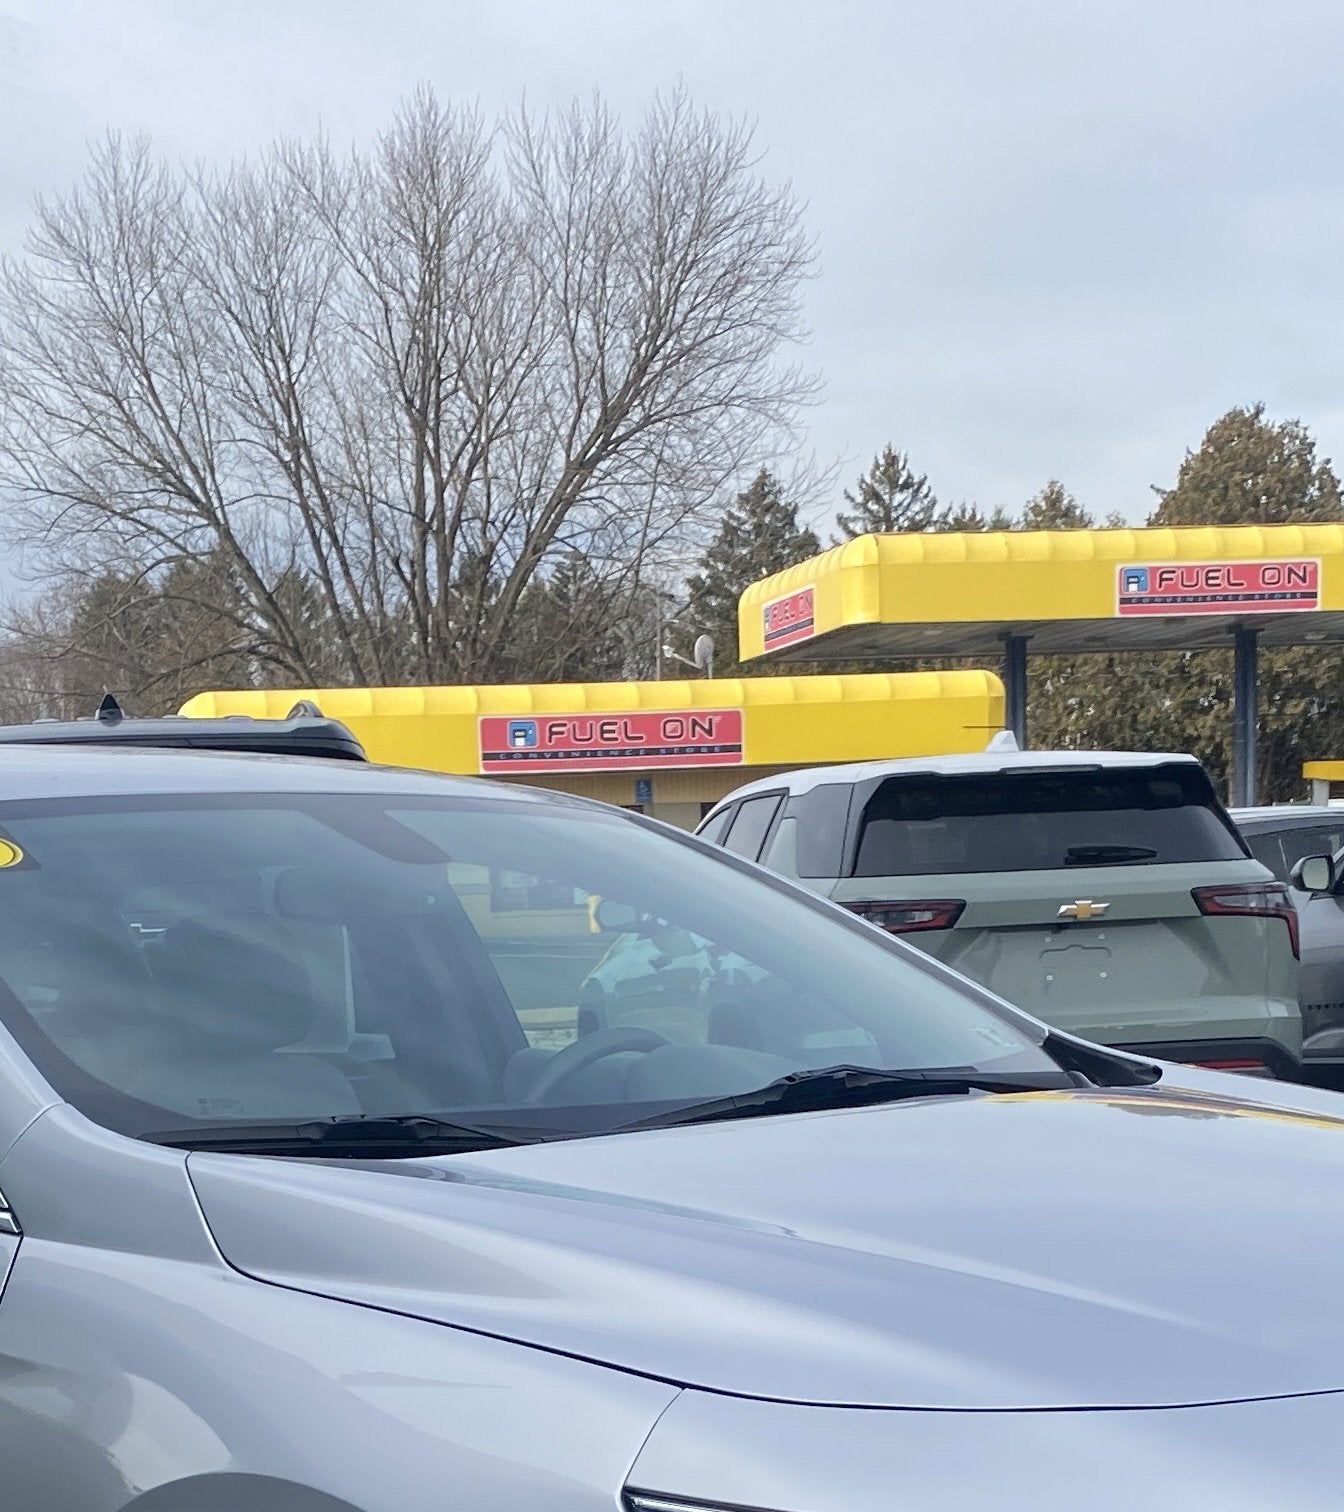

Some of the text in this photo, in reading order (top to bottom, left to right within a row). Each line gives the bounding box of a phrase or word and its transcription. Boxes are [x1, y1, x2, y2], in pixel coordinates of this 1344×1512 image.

[1157, 565, 1308, 589] FUEL ON
[546, 717, 714, 744] FUEL ON
[498, 745, 722, 760] CONVENIENCE STORE
